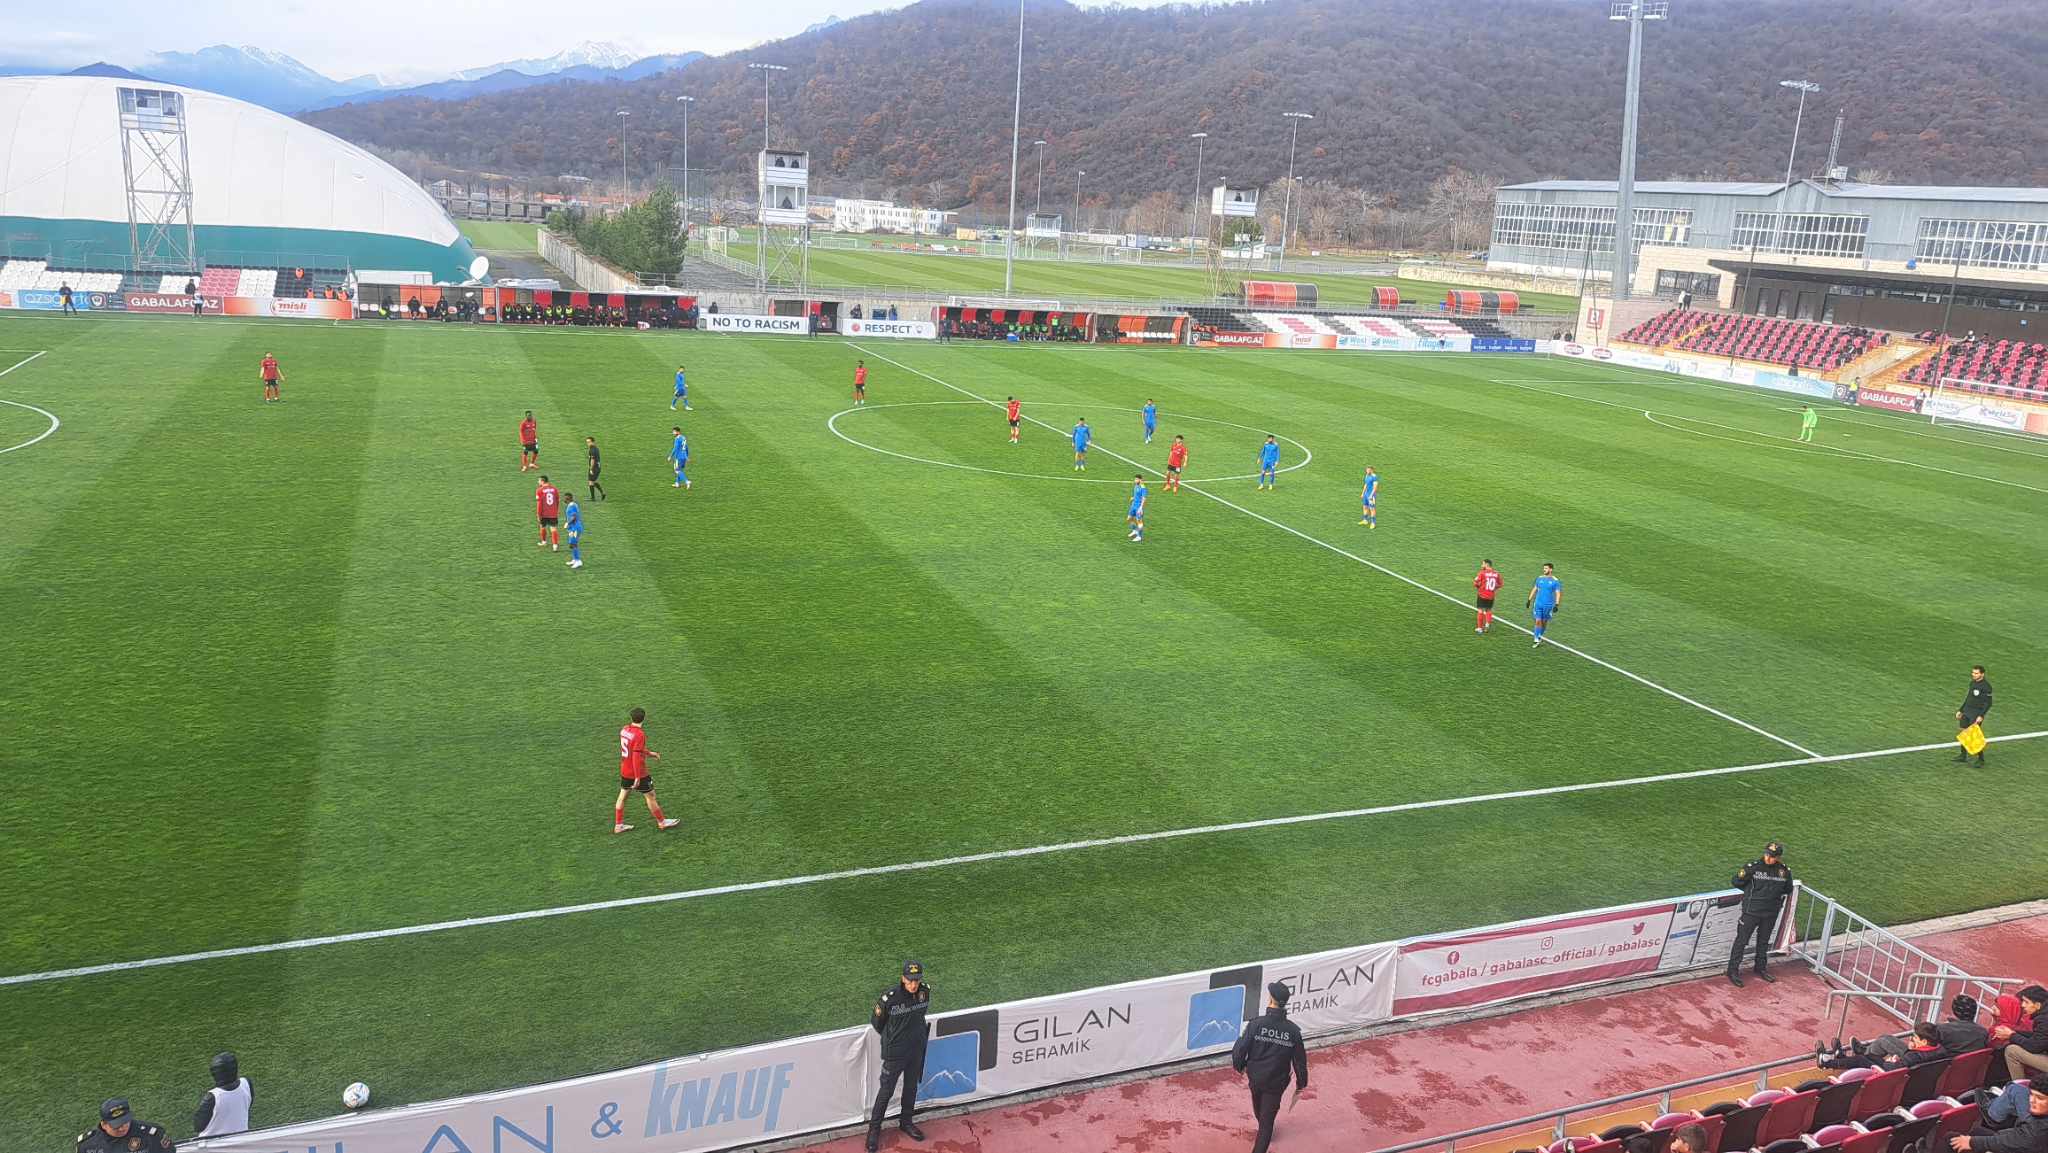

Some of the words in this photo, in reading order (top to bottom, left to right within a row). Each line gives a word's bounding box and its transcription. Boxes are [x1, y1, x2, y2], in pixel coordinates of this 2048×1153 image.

[713, 317, 731, 327] NO
[735, 318, 751, 328] TO
[755, 319, 800, 330] RACISM
[865, 323, 912, 334] RESPECT
[1861, 391, 1915, 407] GABALAFC.A
[546, 493, 554, 506] 8
[1485, 577, 1496, 591] 10
[621, 738, 629, 758] 5
[1422, 968, 1478, 987] fcgabala
[1608, 936, 1661, 955] gabalasc
[1014, 1003, 1131, 1043] GILAN
[1012, 1037, 1091, 1065] SERAMİK
[590, 1102, 624, 1139] &
[644, 1061, 794, 1138] KNAUF
